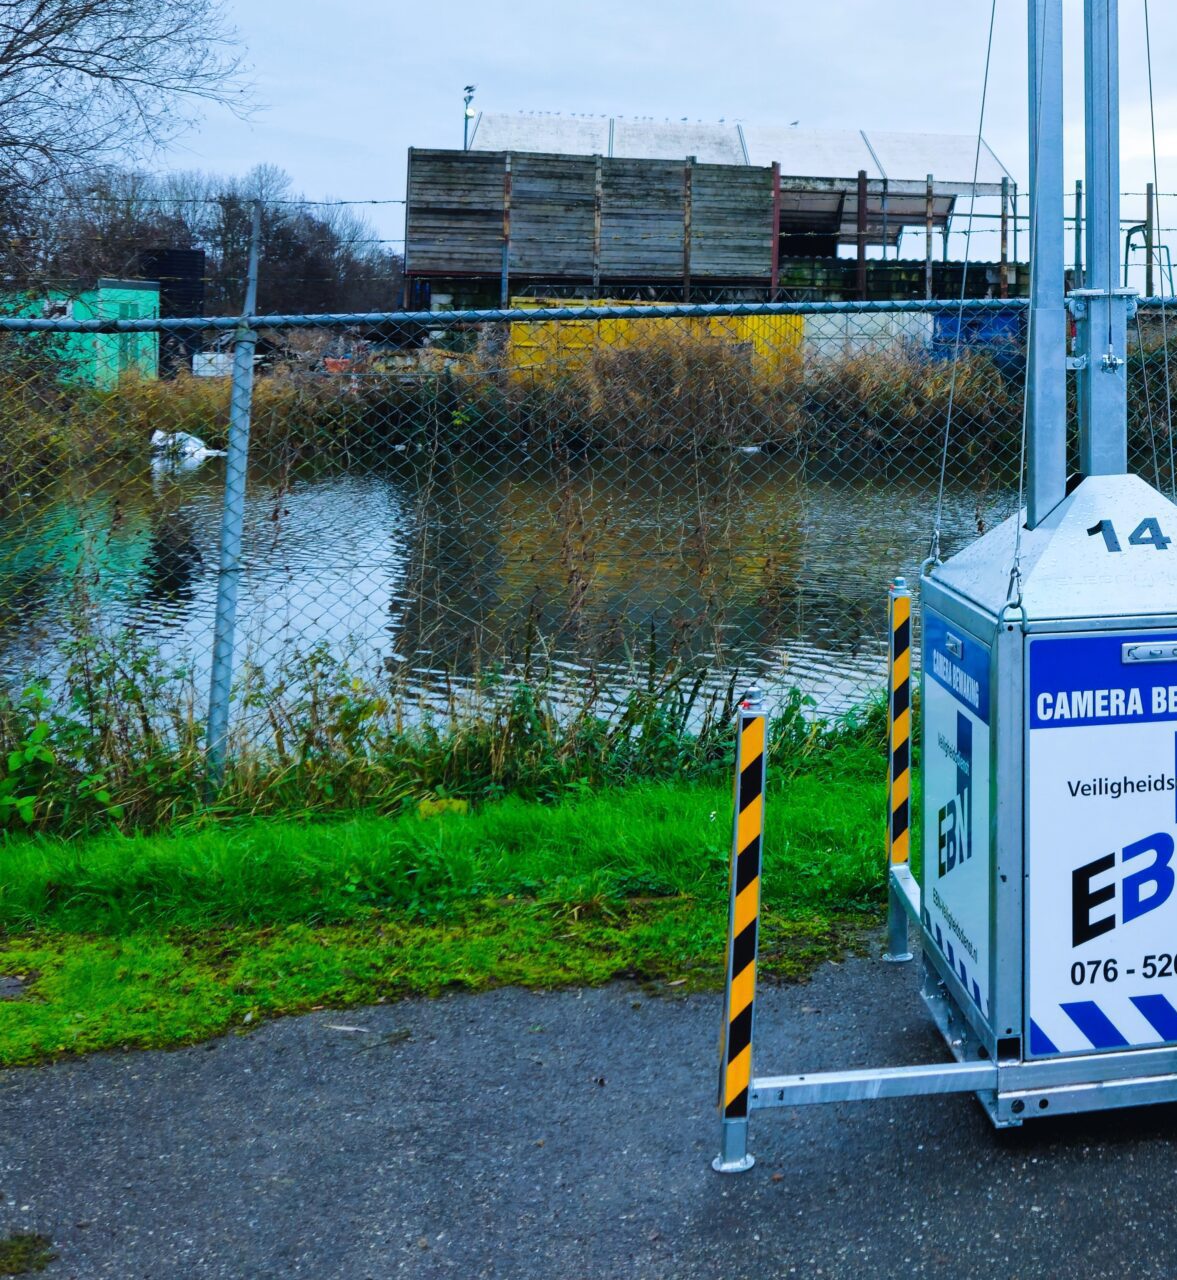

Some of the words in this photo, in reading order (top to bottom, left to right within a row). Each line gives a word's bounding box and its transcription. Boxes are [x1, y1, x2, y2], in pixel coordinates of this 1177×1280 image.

[1086, 517, 1172, 552] 14
[933, 648, 953, 686] CAMERA
[952, 663, 980, 709] BEWAKING
[1036, 687, 1143, 720] CAMERA
[938, 787, 972, 879] EBN
[1070, 959, 1118, 986] 076
